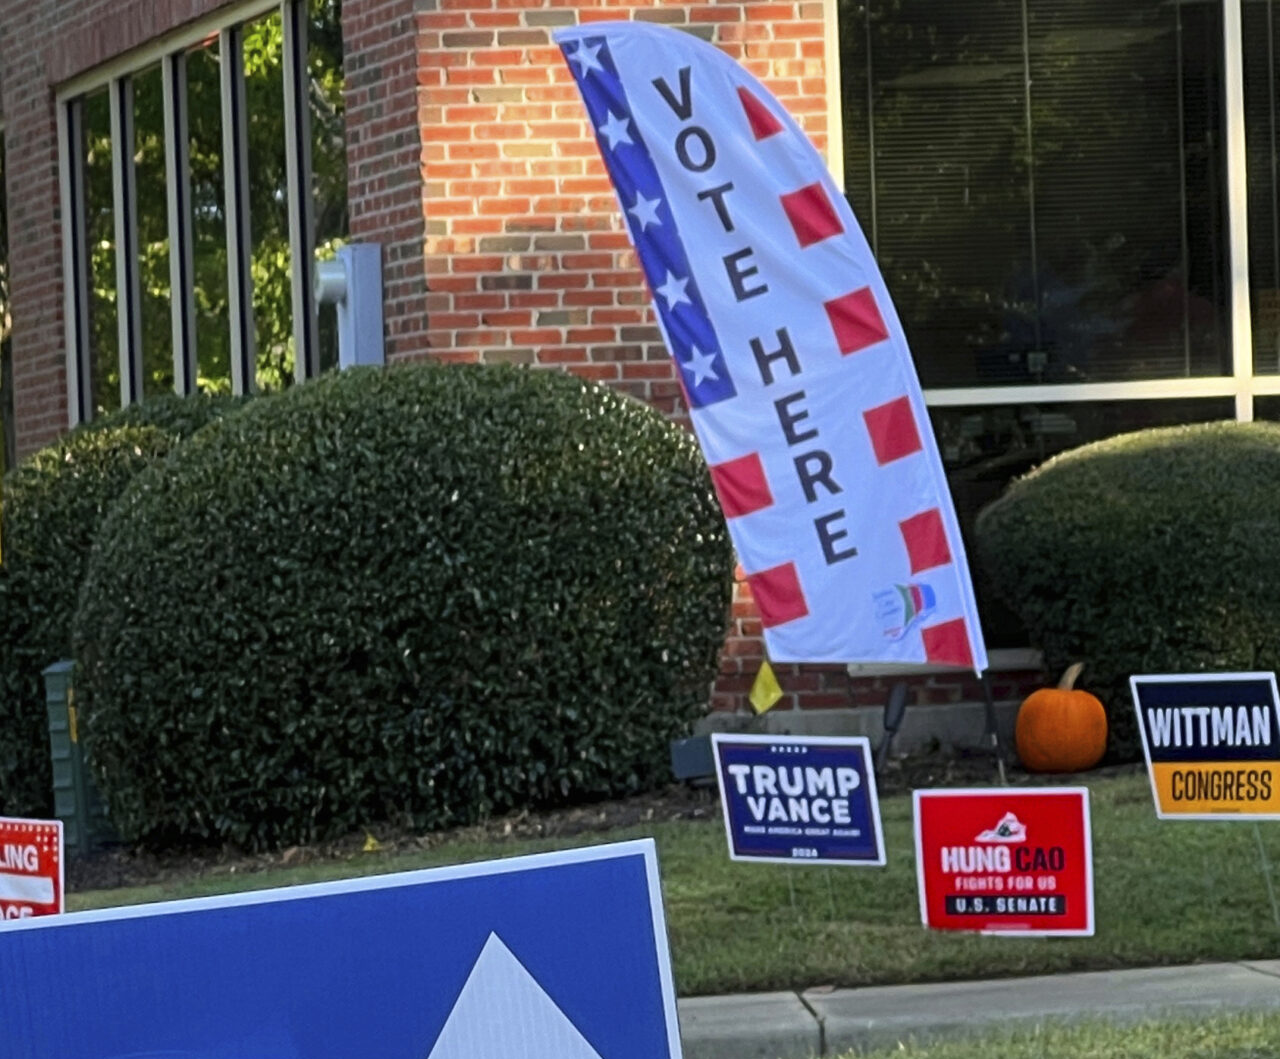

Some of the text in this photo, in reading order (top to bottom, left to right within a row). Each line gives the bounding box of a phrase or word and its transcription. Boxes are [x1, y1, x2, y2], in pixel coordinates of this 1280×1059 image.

[652, 66, 769, 302] VOTE
[749, 327, 857, 565] HERE
[1147, 705, 1271, 747] WITTMAN
[728, 764, 861, 797] TRUMP
[1171, 770, 1272, 801] CONGRESS
[746, 796, 852, 824] VANCE
[940, 845, 1065, 873] HUNG CAO
[955, 875, 1057, 891] FIGHTS FOR US
[955, 896, 1058, 913] U.S. SENATE
